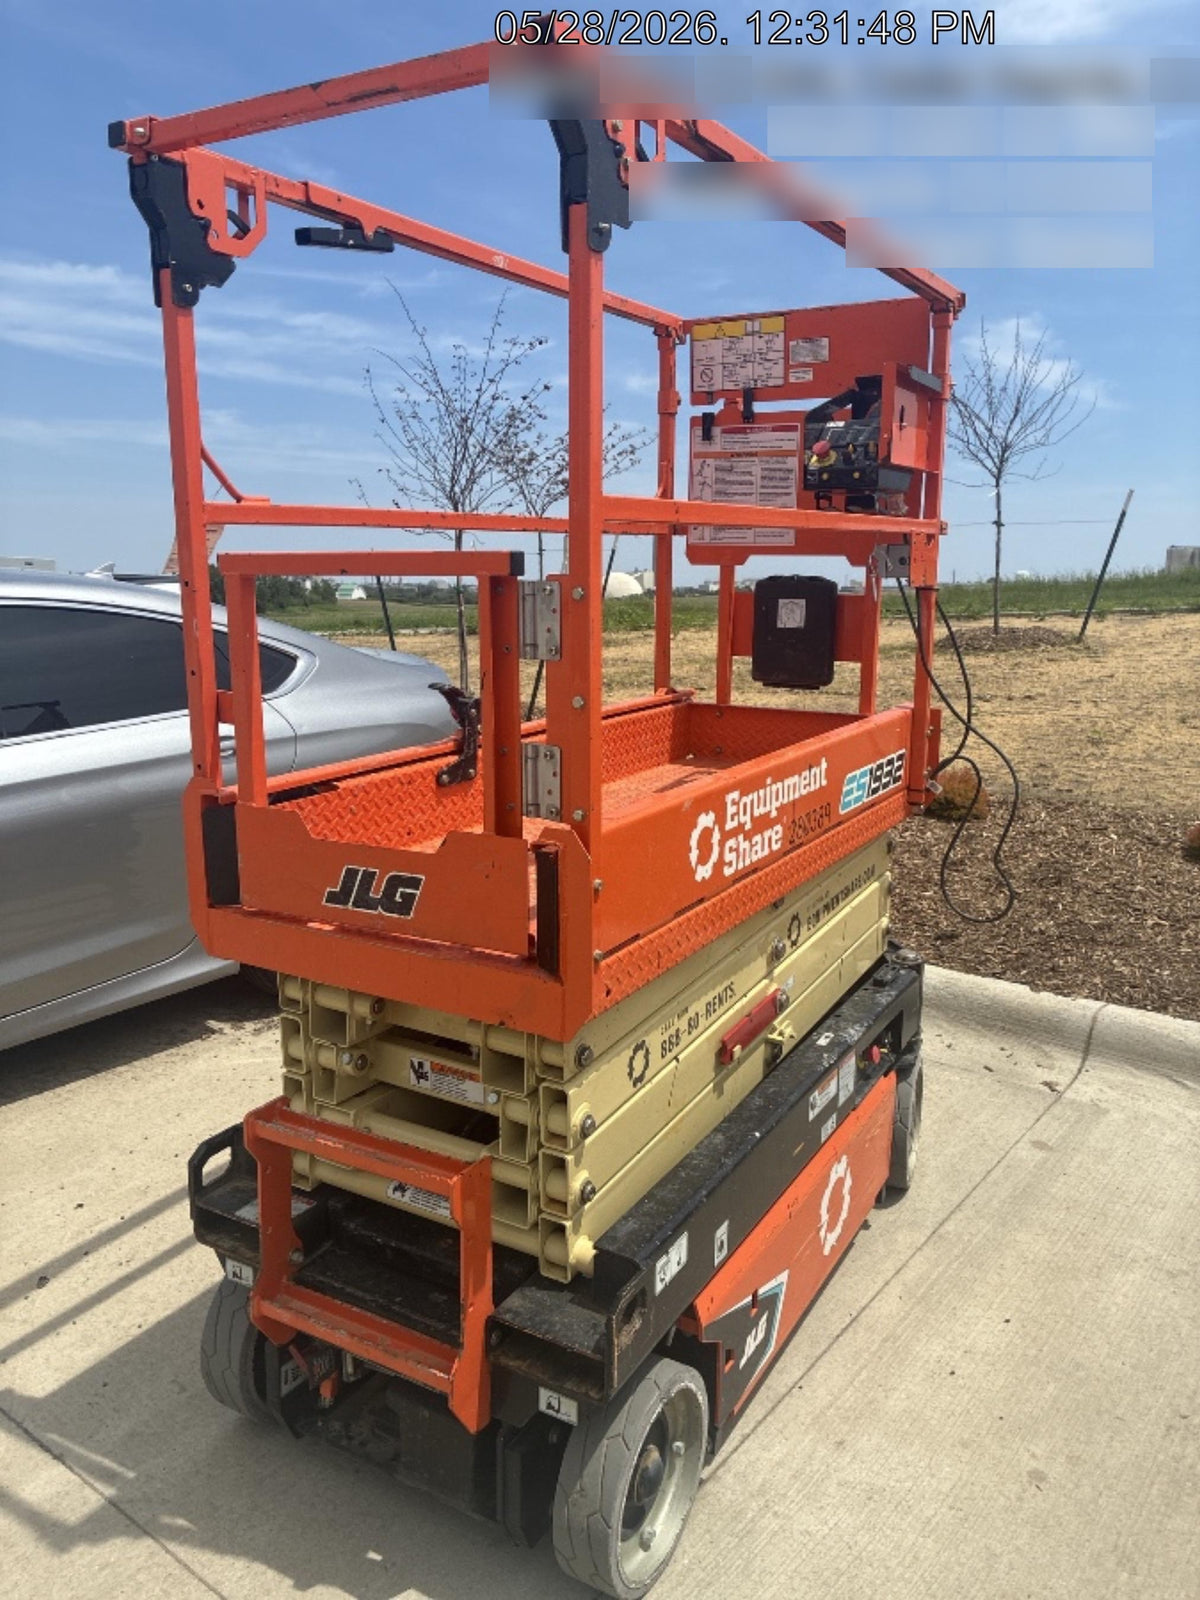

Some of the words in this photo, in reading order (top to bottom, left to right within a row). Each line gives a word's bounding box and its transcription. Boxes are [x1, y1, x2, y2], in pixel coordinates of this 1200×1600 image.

[725, 757, 828, 831] Equipment
[839, 749, 906, 815] ES1932
[723, 823, 783, 877] Share
[322, 865, 425, 919] JLG
